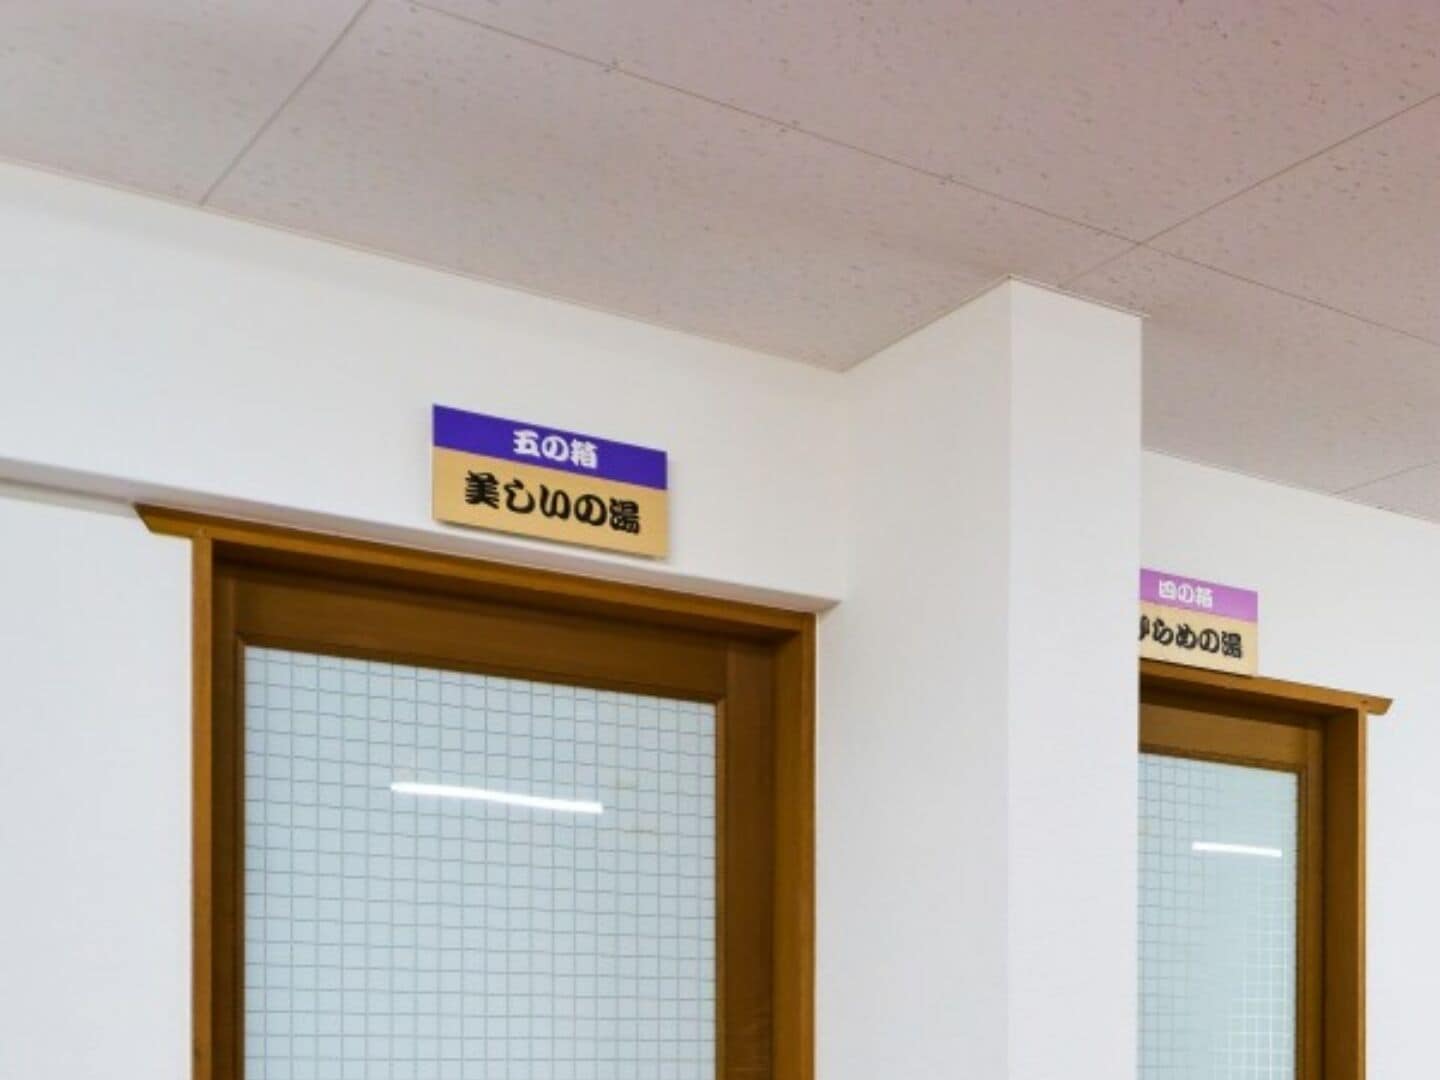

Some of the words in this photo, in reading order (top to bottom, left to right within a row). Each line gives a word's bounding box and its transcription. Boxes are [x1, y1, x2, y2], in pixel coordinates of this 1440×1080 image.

[465, 470, 641, 535] 美しいの湯
